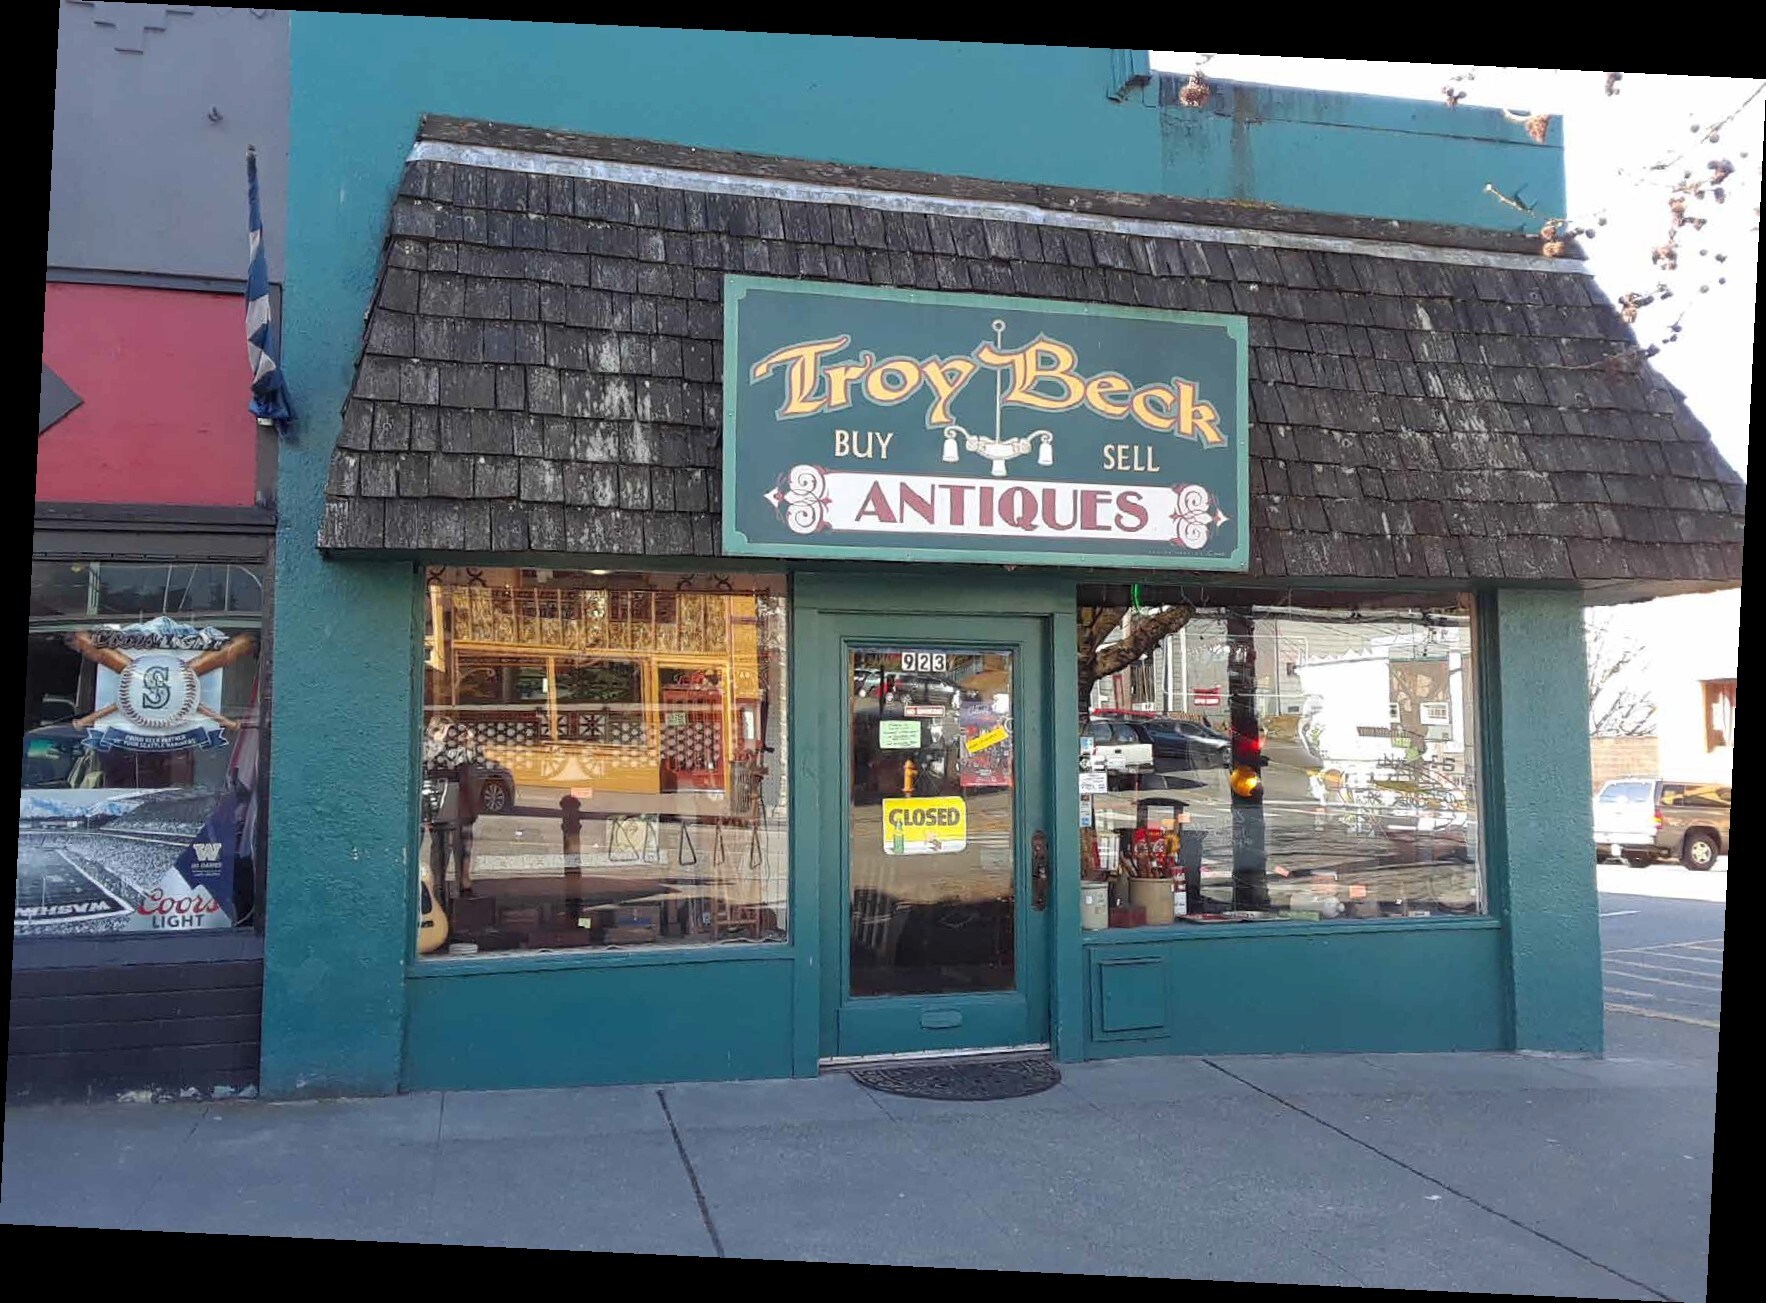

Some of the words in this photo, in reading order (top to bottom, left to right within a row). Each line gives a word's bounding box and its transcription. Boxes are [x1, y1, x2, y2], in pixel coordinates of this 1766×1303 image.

[750, 334, 979, 429] Troy
[973, 331, 1229, 449] Beck
[834, 429, 894, 460] BUY
[1103, 444, 1160, 473] SELL
[854, 479, 1149, 533] ANTIQUES
[903, 653, 945, 671] 923
[888, 806, 961, 827] CLOSED
[137, 887, 220, 915] Coors
[151, 914, 205, 929] LIGHT
